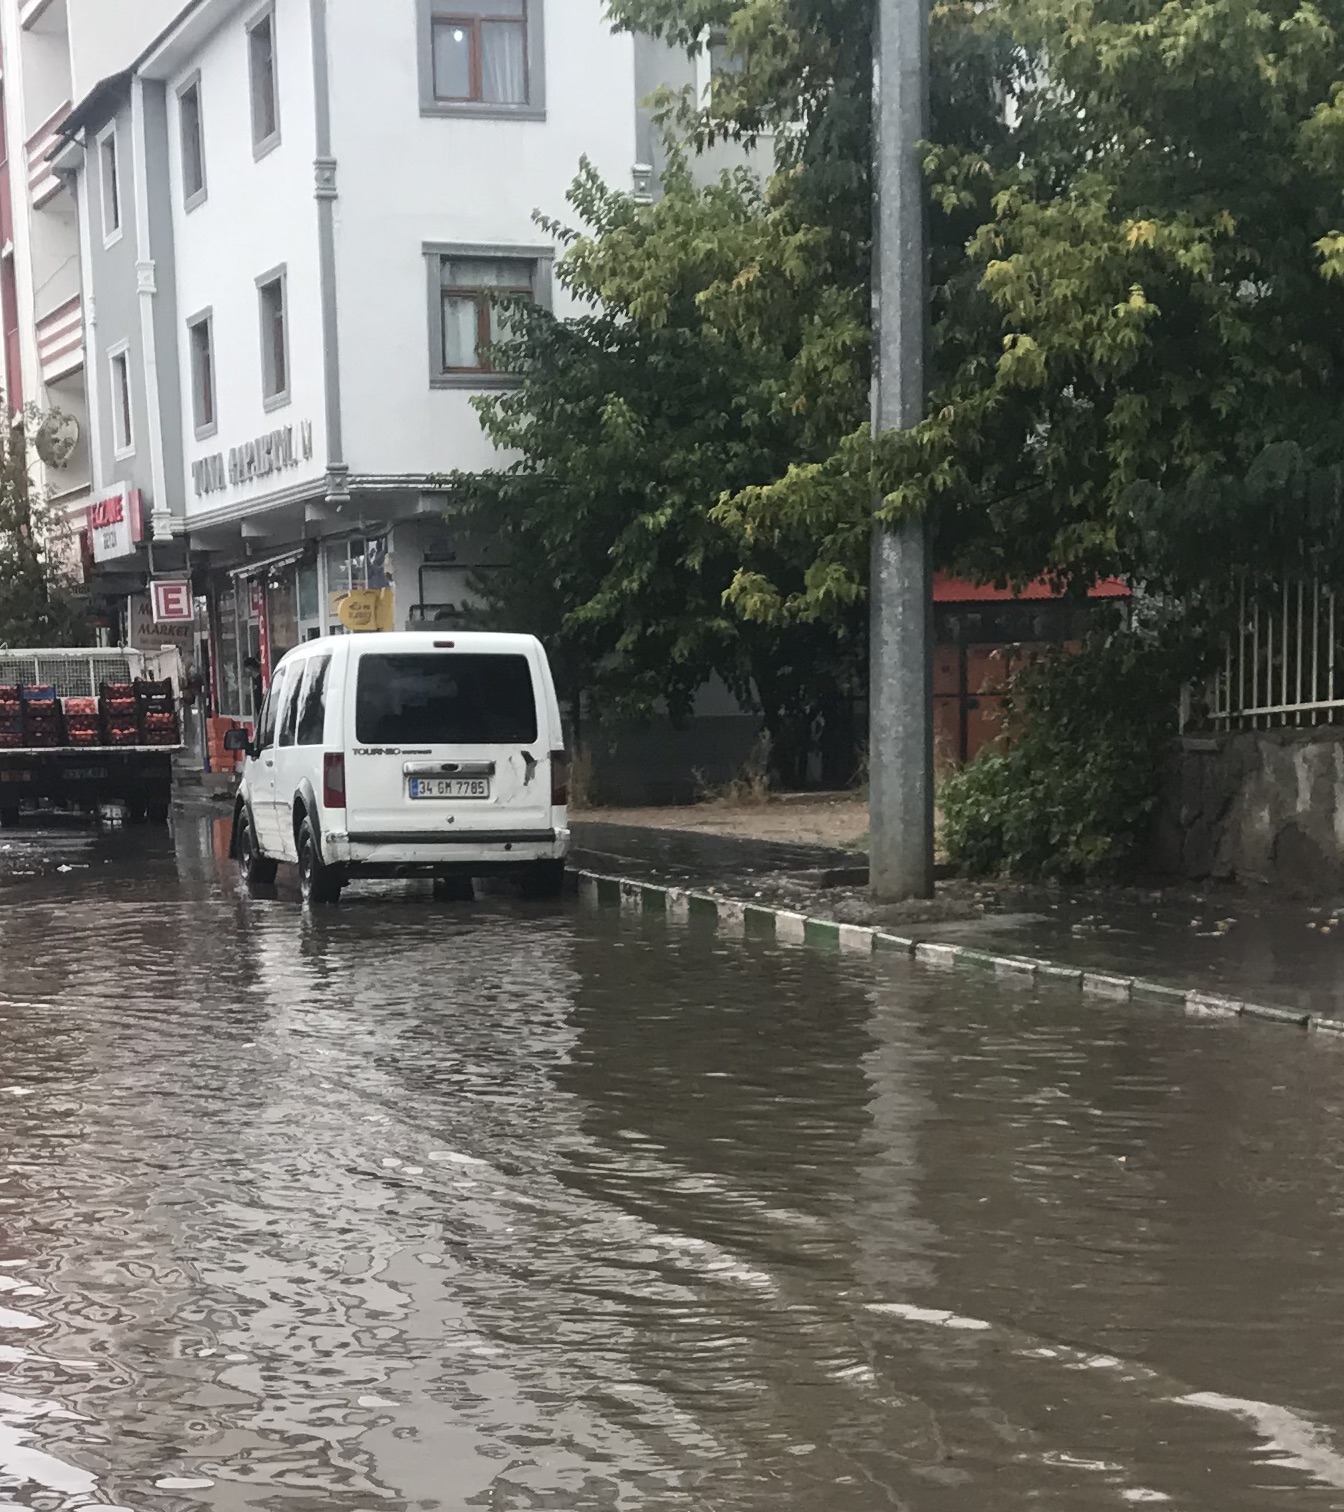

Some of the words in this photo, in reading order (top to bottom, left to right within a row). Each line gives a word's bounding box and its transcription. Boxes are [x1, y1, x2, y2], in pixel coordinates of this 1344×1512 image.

[162, 587, 184, 615] E
[137, 623, 189, 638] MARKET
[352, 748, 401, 756] TOURNEO
[419, 781, 433, 795] 34
[437, 781, 452, 795] GM
[456, 781, 485, 795] 7785
